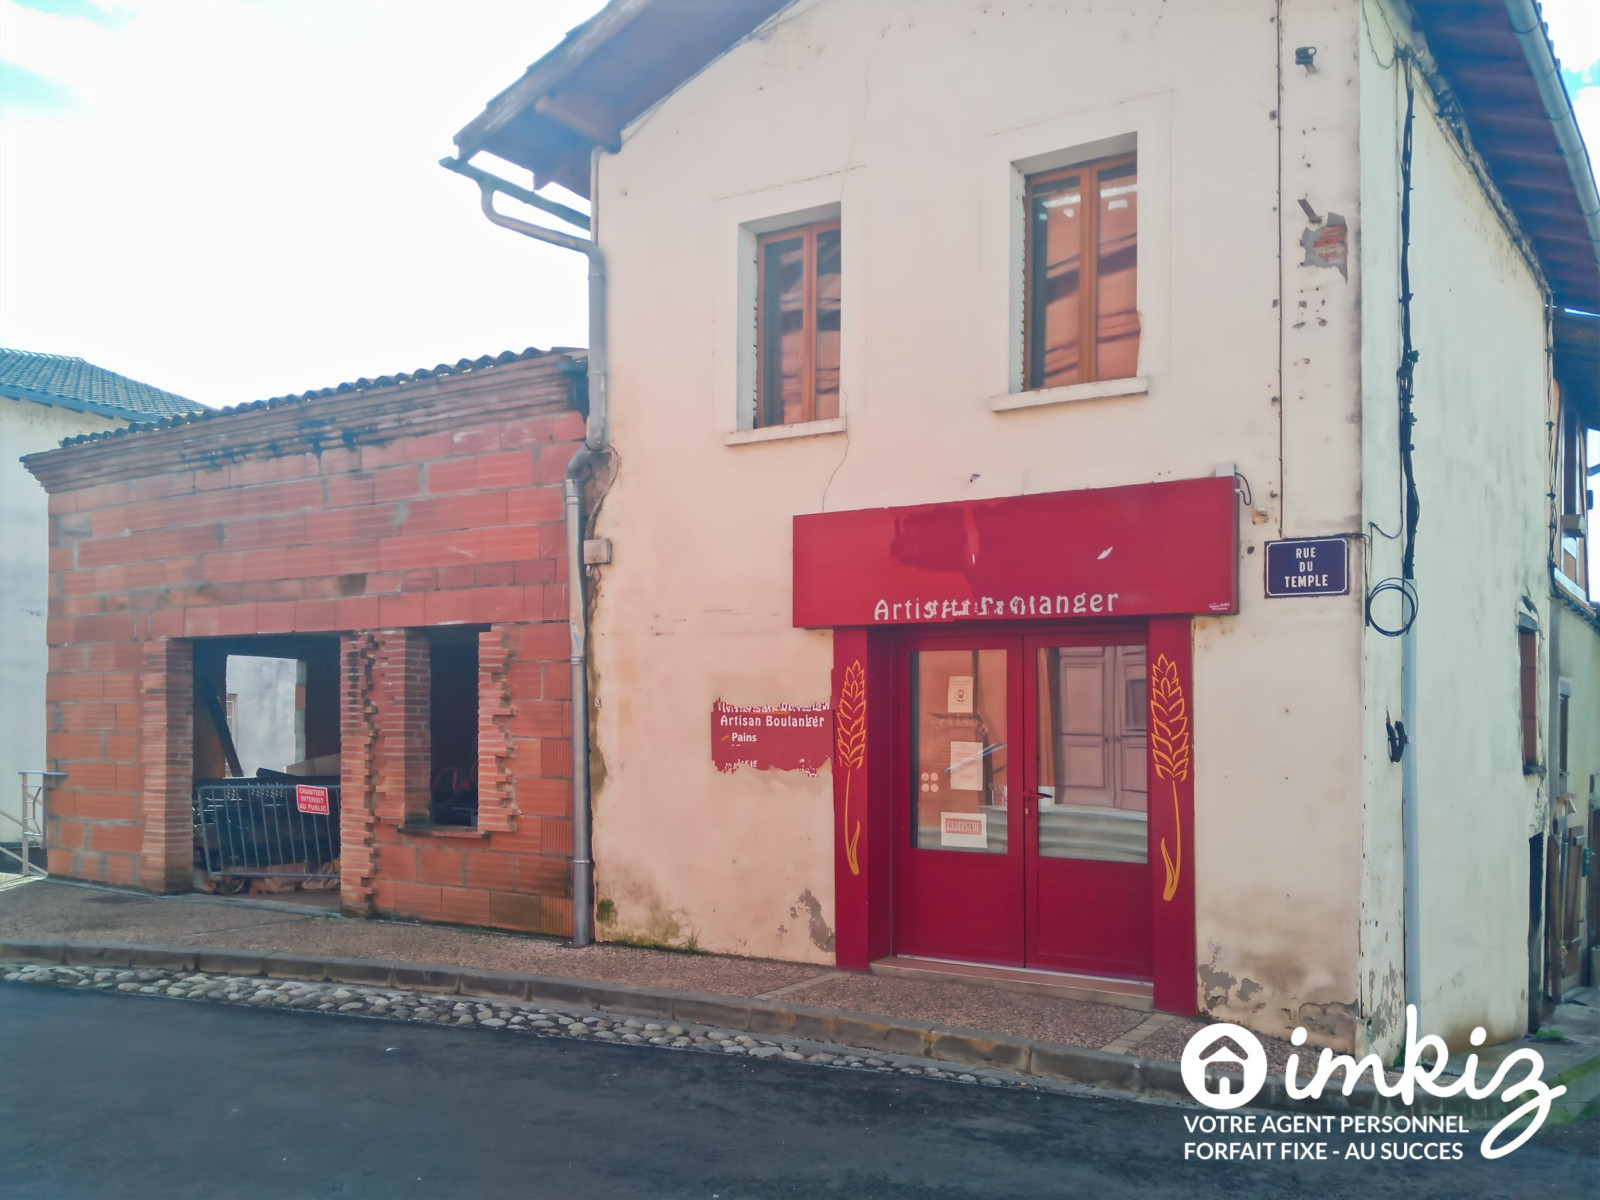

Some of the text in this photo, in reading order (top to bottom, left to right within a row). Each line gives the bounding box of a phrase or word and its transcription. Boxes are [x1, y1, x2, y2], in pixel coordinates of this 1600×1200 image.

[1295, 547, 1317, 559] RUE
[1299, 561, 1314, 573] DU
[1284, 574, 1329, 588] TEMPLE
[720, 714, 825, 728] Artisan Boulanger
[731, 732, 758, 743] Pains
[299, 788, 325, 797] CHANTIER
[300, 796, 324, 804] INTERDIT
[308, 804, 326, 812] PUBLIC
